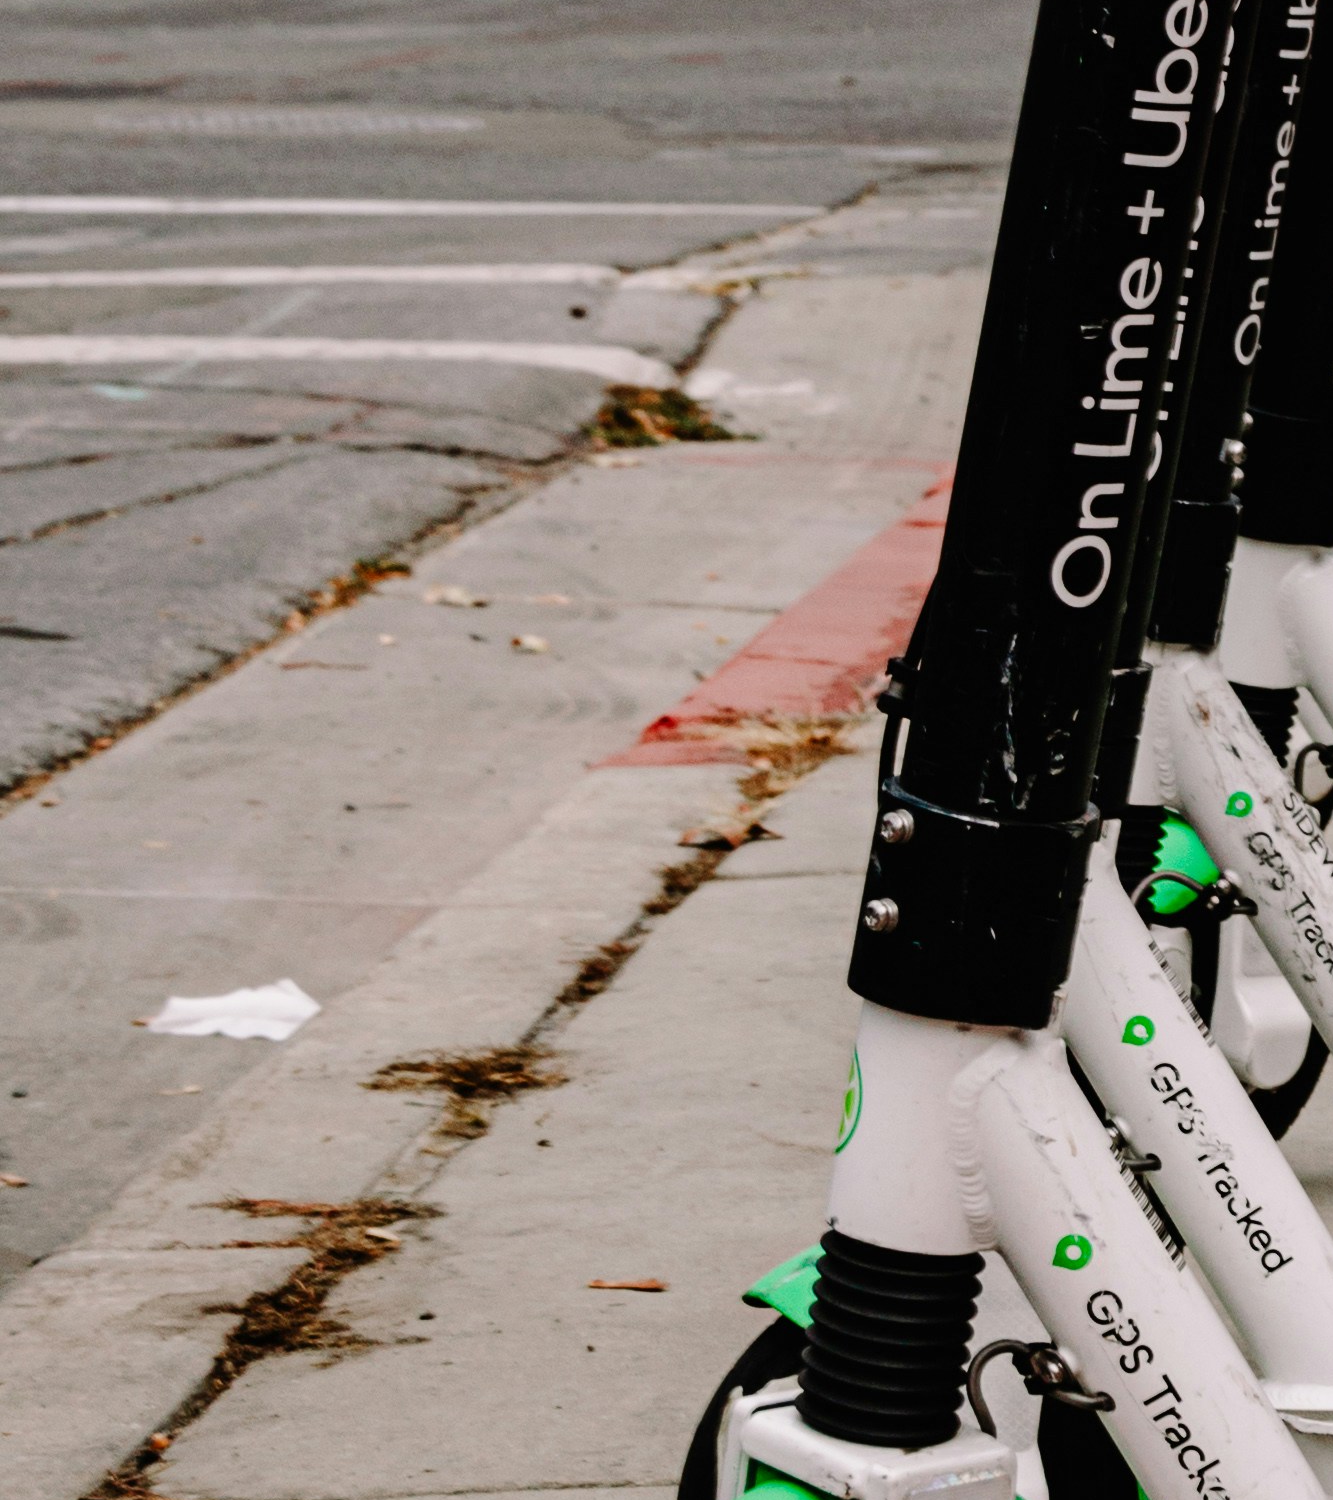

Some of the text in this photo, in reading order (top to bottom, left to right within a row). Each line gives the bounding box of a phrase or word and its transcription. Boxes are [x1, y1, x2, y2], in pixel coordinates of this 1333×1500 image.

[1247, 120, 1297, 262] Lime
[1072, 255, 1164, 459] Lime
[1233, 276, 1271, 366] On
[1050, 481, 1126, 609] On
[1086, 1289, 1154, 1375] GPS
